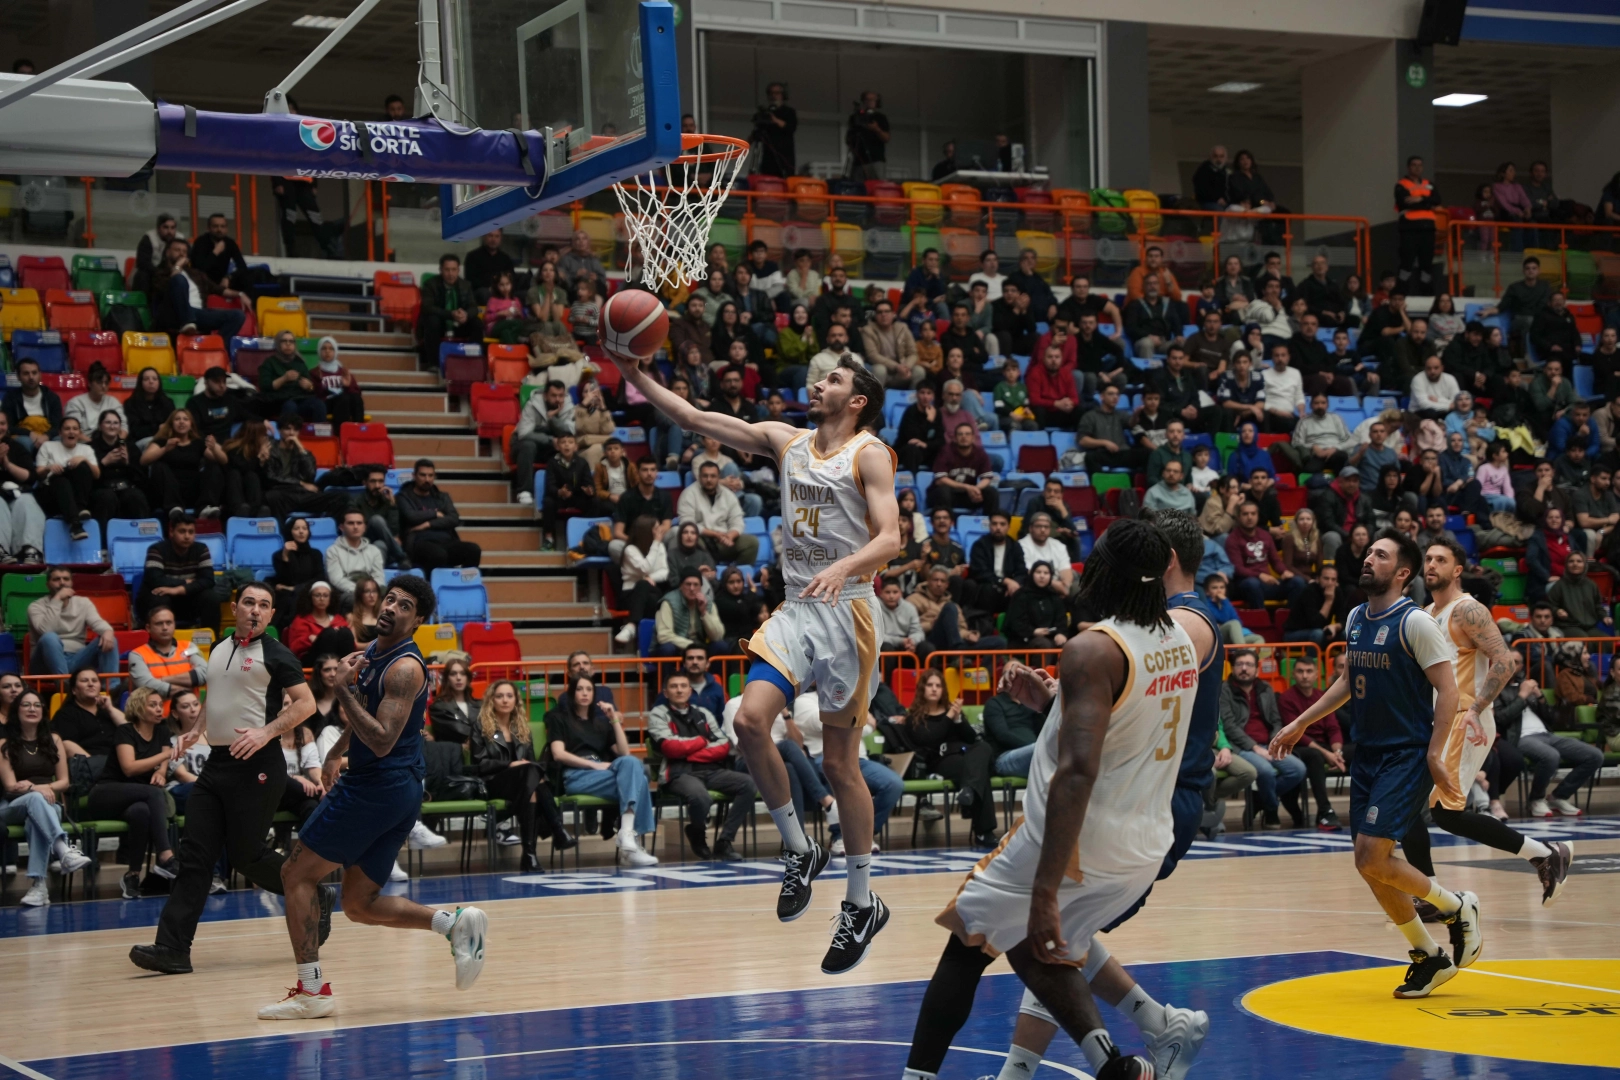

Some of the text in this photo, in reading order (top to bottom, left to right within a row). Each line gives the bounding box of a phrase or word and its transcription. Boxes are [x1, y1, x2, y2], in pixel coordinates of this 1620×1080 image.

[790, 484, 835, 505] KONYA
[793, 507, 820, 538] 24
[1143, 645, 1195, 673] COFFEY
[1355, 674, 1367, 700] 9
[1155, 696, 1180, 761] 3
